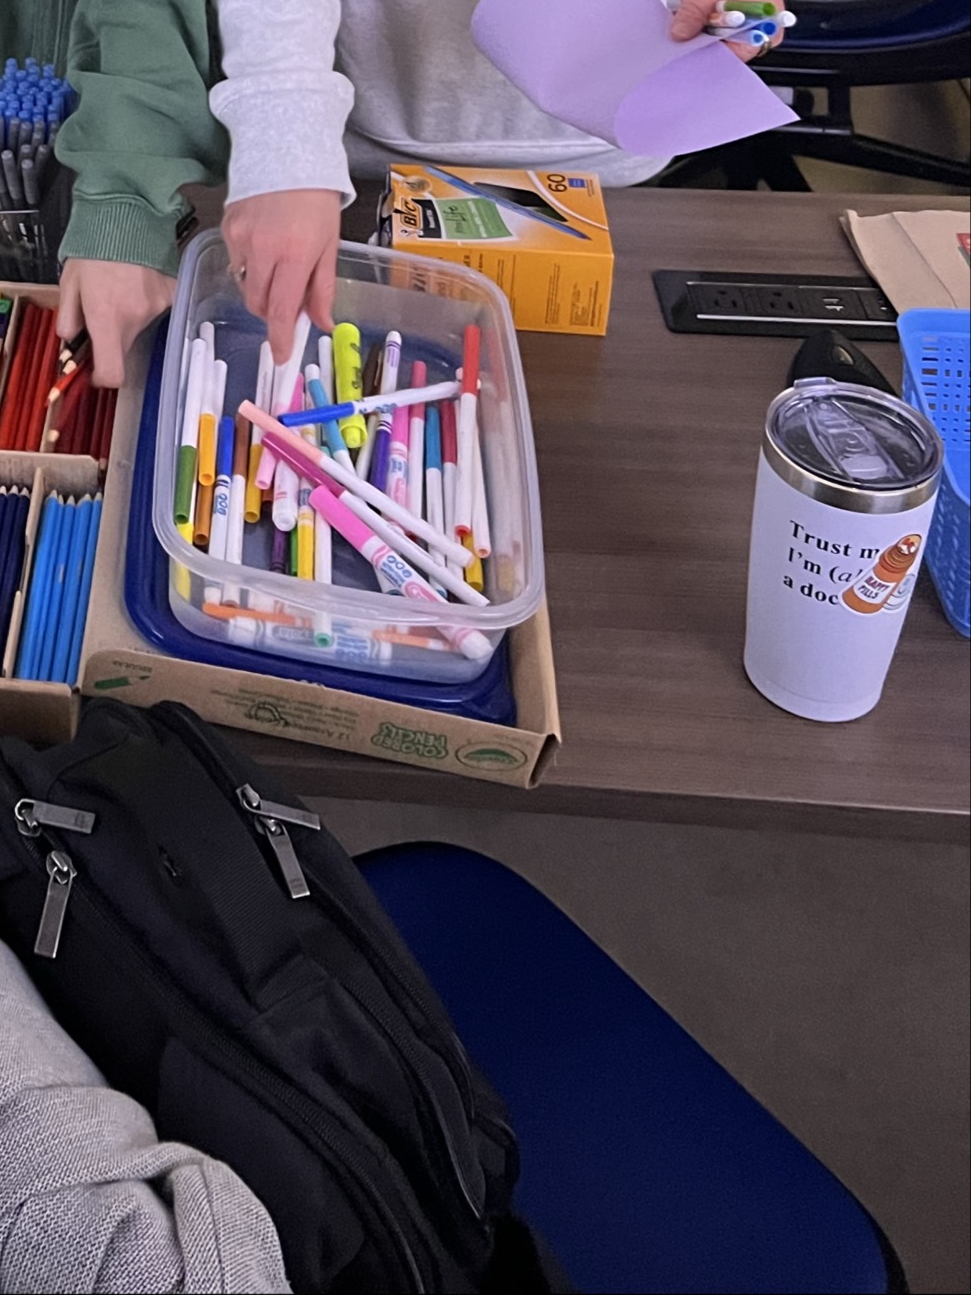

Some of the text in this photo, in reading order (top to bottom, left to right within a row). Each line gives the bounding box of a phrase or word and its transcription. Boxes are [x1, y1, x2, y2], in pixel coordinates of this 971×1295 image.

[546, 173, 568, 193] 60
[399, 197, 420, 229] BIC
[789, 519, 880, 560] Trust m
[787, 547, 822, 576] I'm
[782, 575, 839, 606] a doc
[857, 584, 880, 600] PILLS
[863, 575, 892, 593] HAPPY
[370, 734, 449, 760] COLORED
[380, 722, 447, 748] PENCILS
